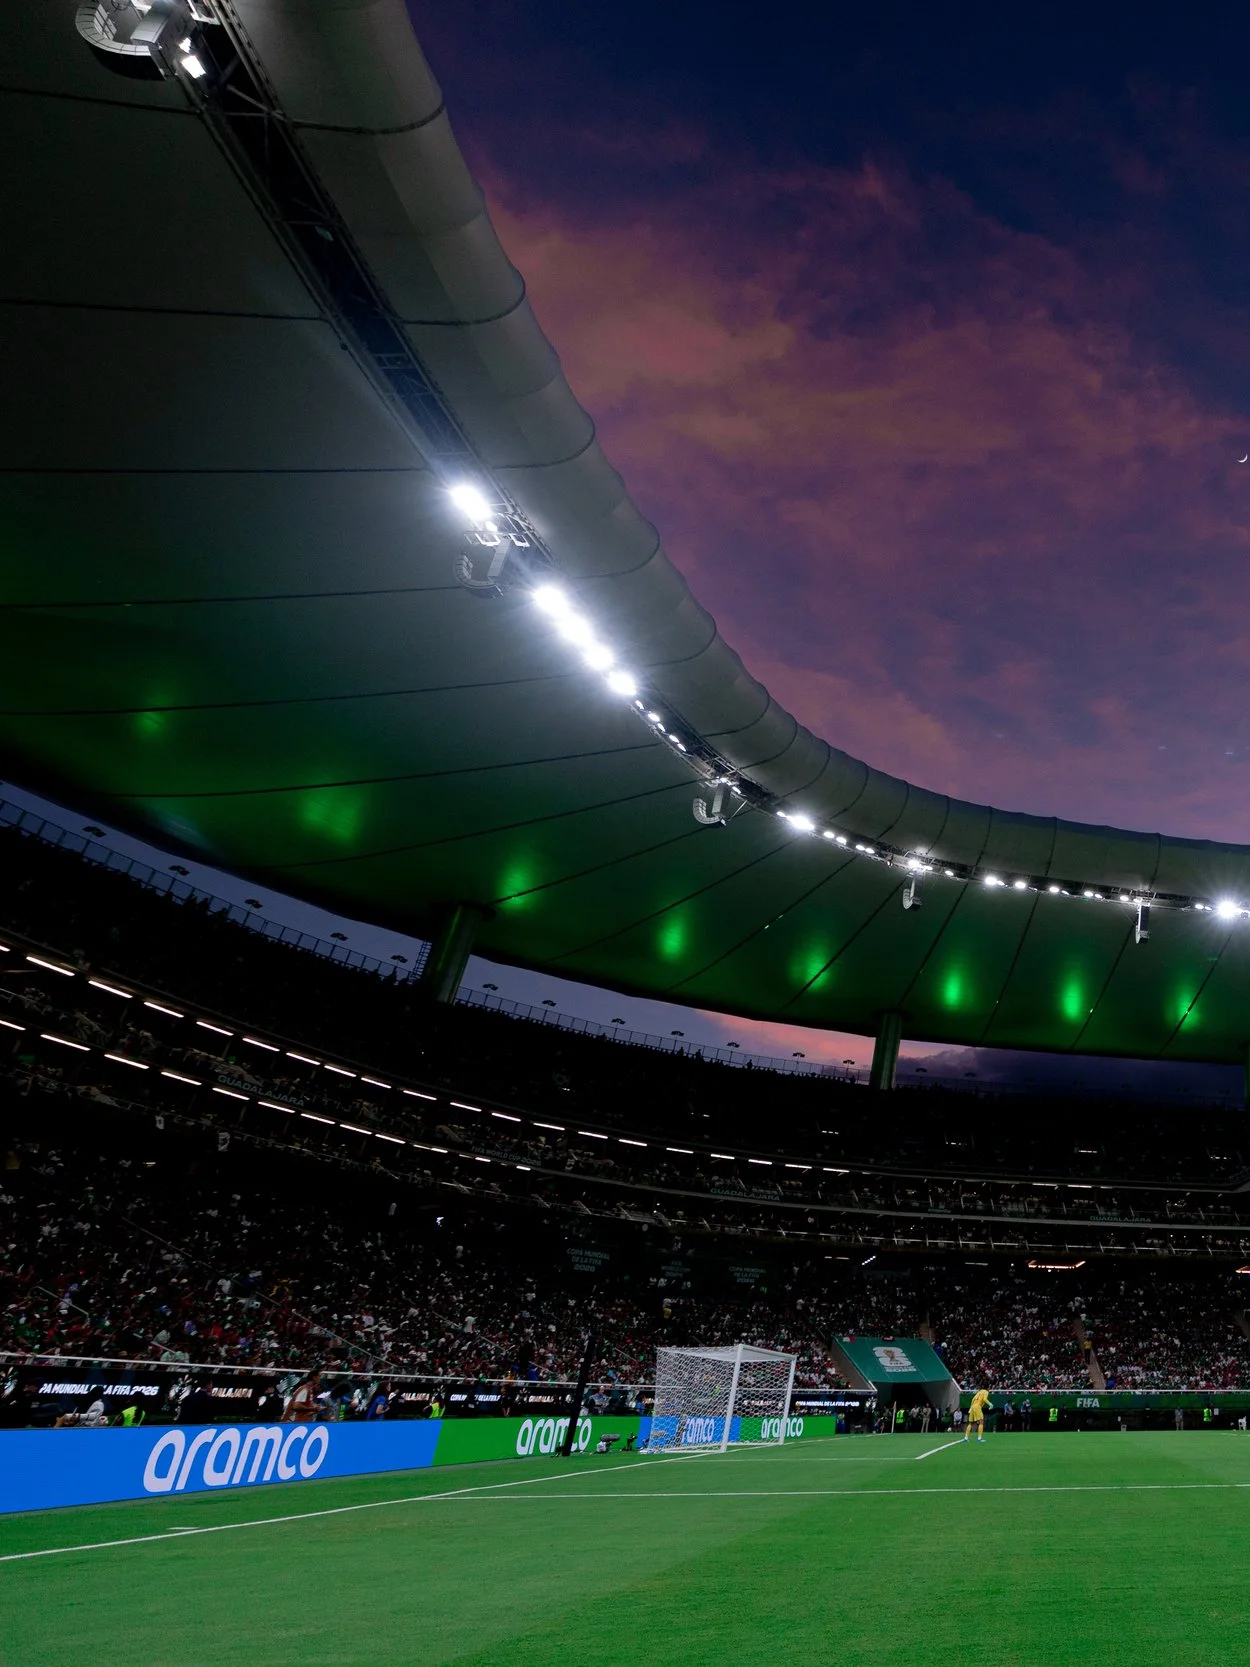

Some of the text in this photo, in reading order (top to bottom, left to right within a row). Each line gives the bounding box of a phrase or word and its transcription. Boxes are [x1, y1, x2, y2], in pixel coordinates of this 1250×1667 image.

[217, 1075, 305, 1107] GUADALAJARA
[710, 1187, 780, 1201] GUADALAJARA
[566, 1247, 610, 1261] COPA MUNDIAL
[38, 1383, 53, 1394] PA
[51, 1384, 89, 1394] MUNDIAL
[111, 1385, 131, 1395] FIFA
[1076, 1397, 1100, 1408] FIFA
[143, 1425, 329, 1493] aramco
